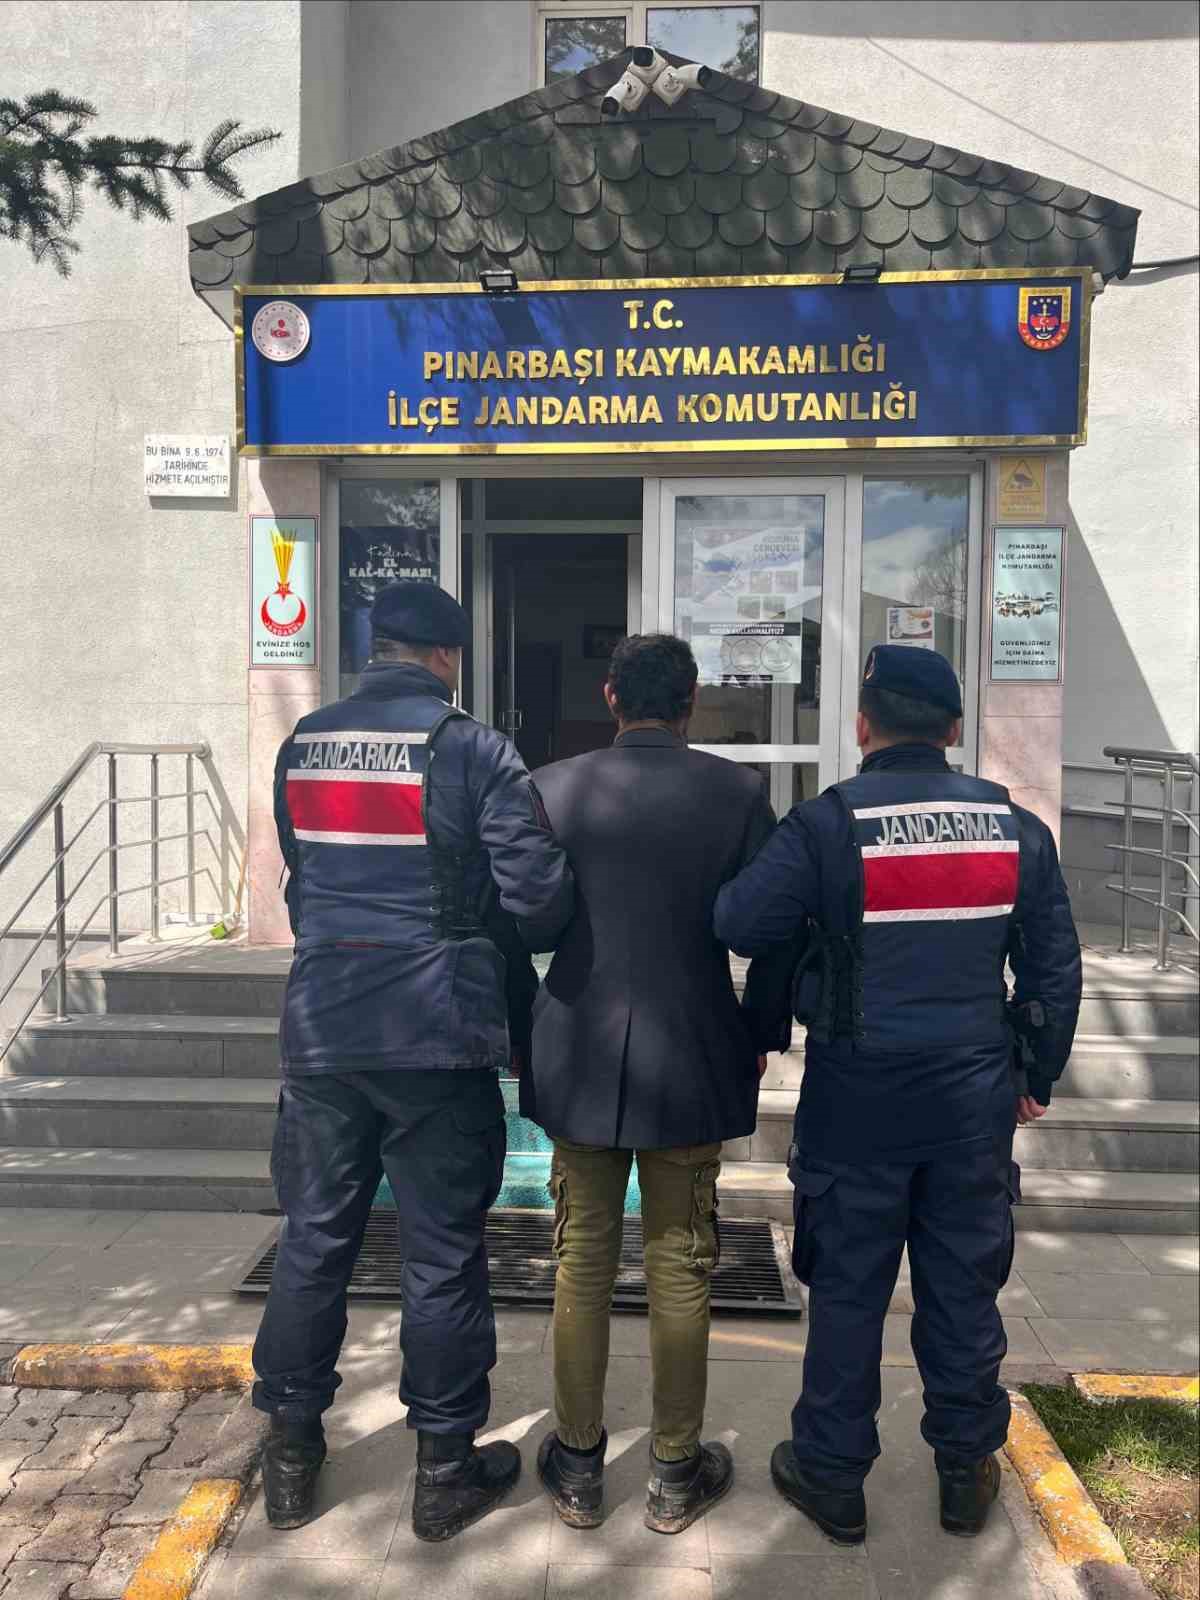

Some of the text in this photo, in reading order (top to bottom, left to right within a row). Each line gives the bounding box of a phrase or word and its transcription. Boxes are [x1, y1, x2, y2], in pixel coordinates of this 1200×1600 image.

[623, 299, 684, 330] T.C.
[423, 334, 886, 385] PINARBAŞI KAYMAKAMLIĞI
[387, 381, 918, 433] İLÇE JANDARMA KOMUTANLIĞI
[146, 446, 158, 457] BU
[1017, 553, 1057, 561] JANDARMA
[299, 741, 412, 771] JANDARMA
[875, 812, 1006, 846] JANDARMA
